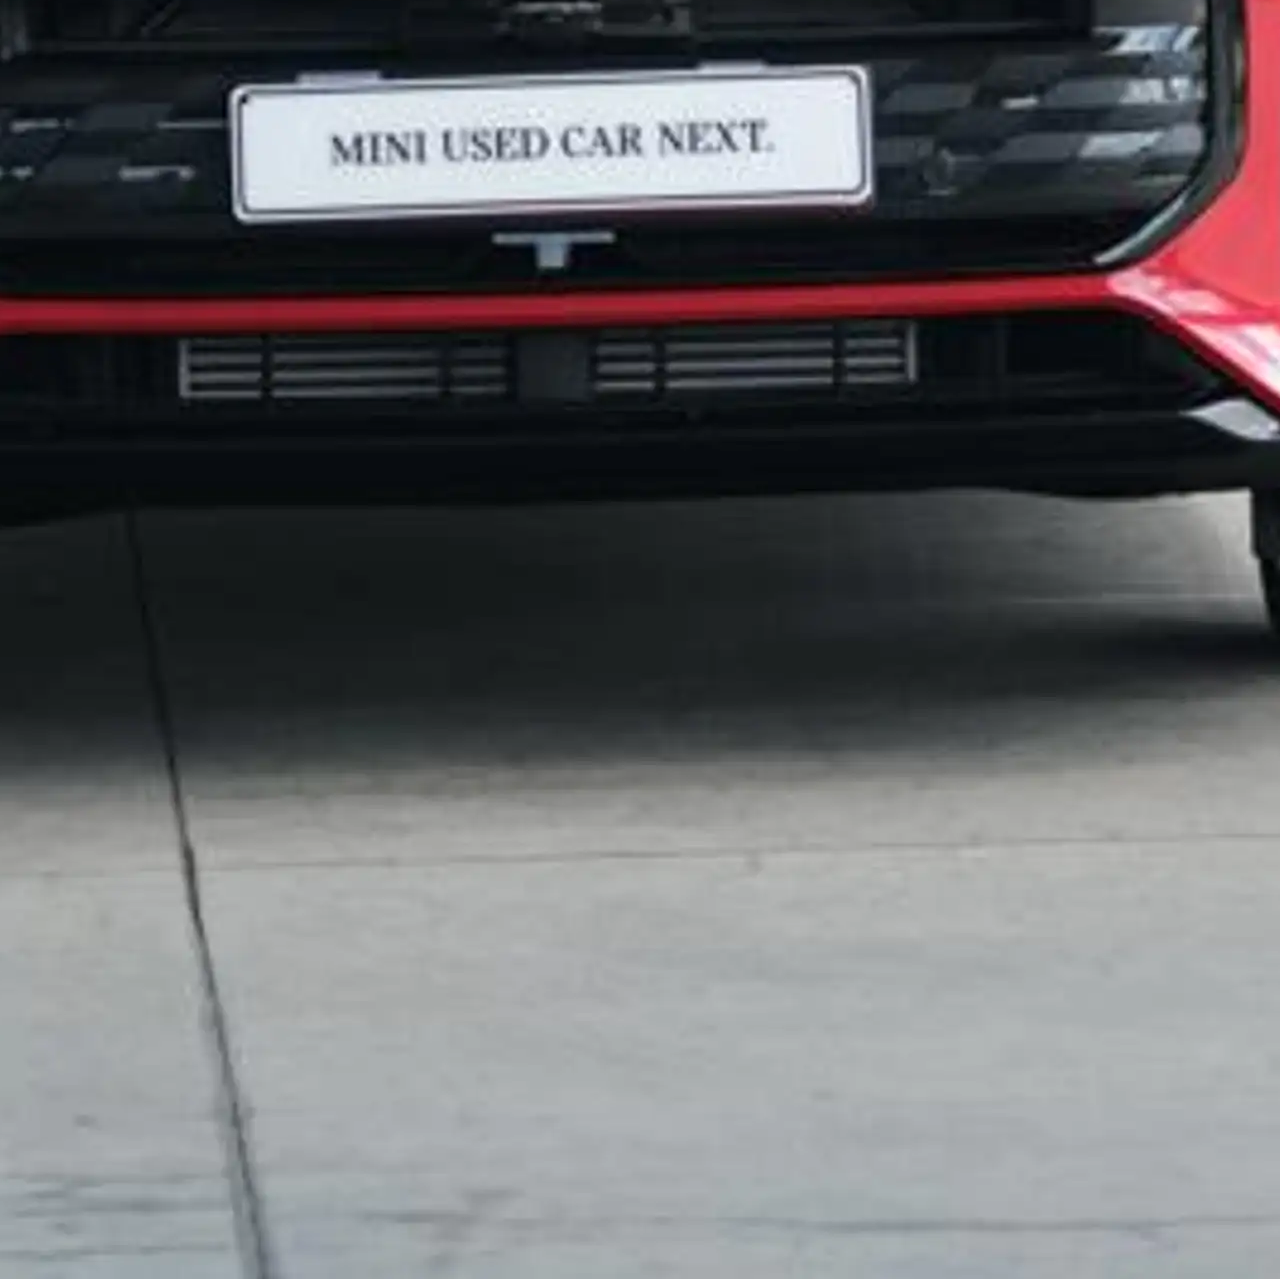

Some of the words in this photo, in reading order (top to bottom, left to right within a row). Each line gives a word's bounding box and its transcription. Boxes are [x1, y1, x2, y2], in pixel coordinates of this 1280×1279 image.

[330, 129, 426, 166] MINI
[441, 125, 551, 162] USED
[559, 122, 643, 158] CAR
[657, 117, 776, 156] NEXT.
